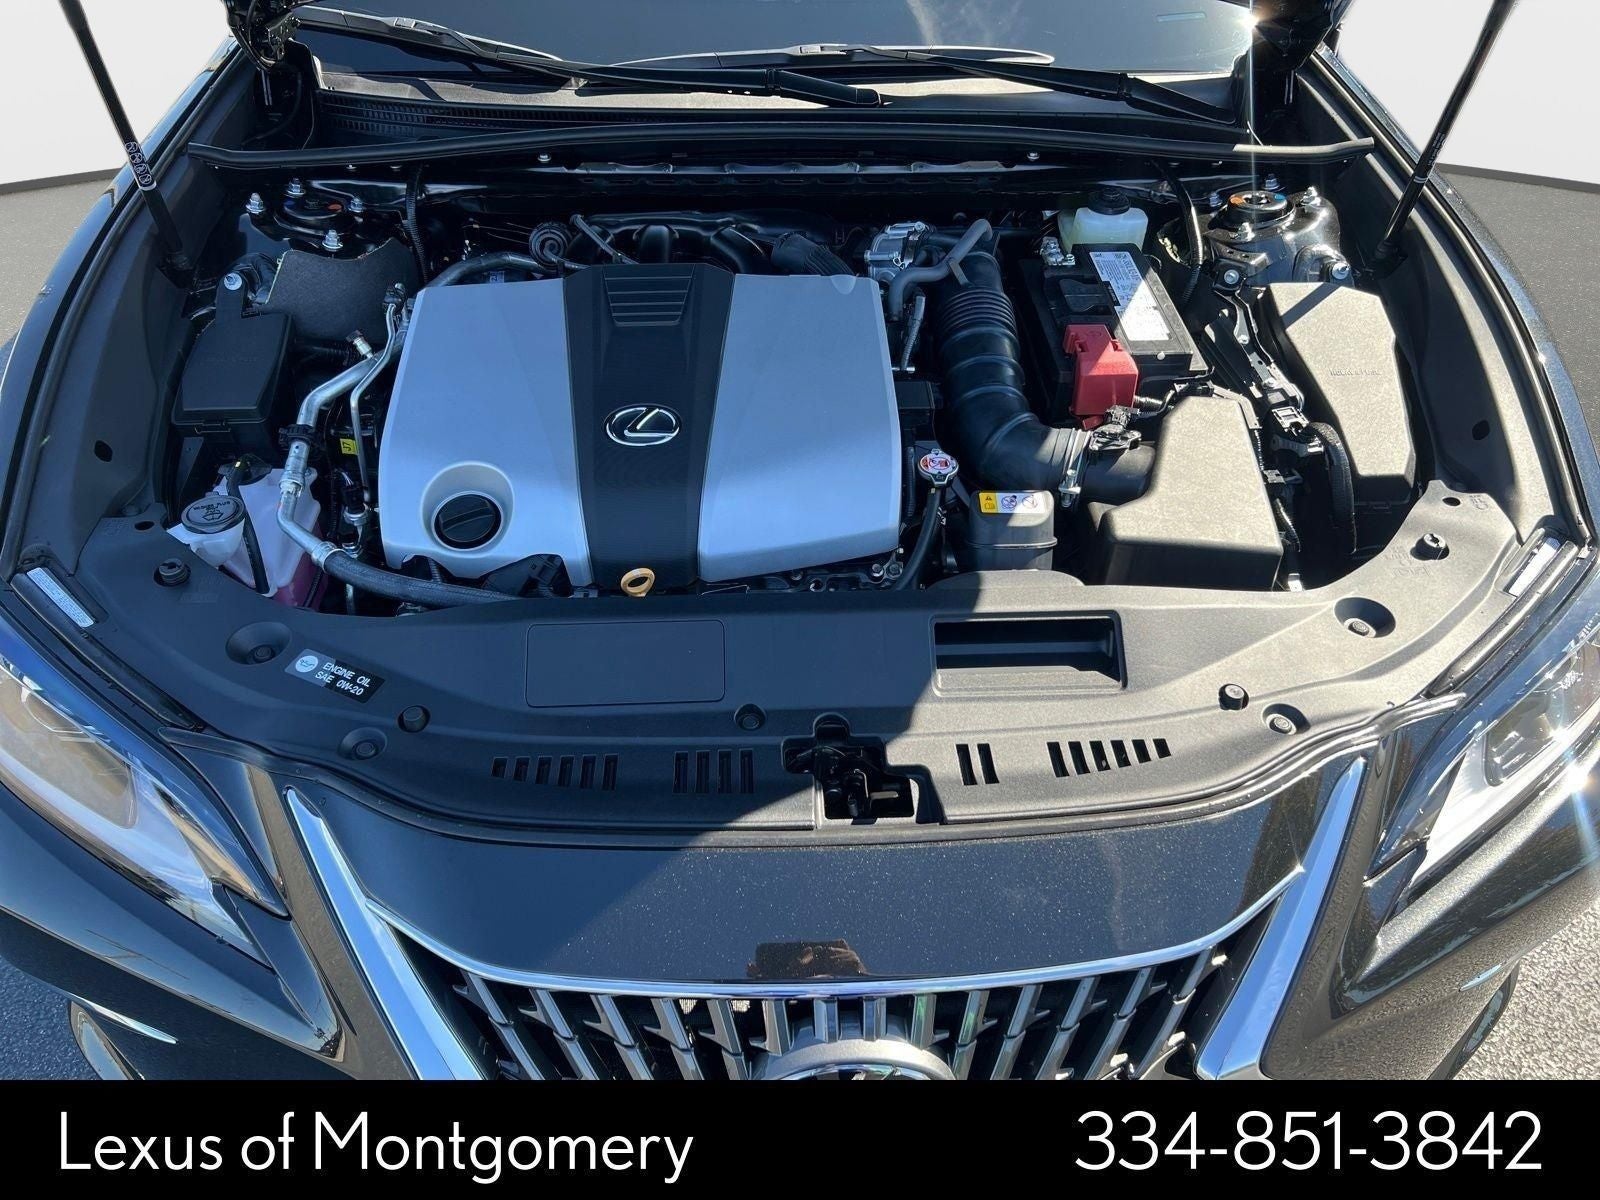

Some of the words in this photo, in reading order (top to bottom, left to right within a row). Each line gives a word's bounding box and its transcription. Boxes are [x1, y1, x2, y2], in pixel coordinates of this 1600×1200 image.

[315, 671, 335, 684] SAE
[336, 679, 364, 696] 0W-20
[322, 662, 356, 680] ENGINE
[356, 675, 372, 688] OIL
